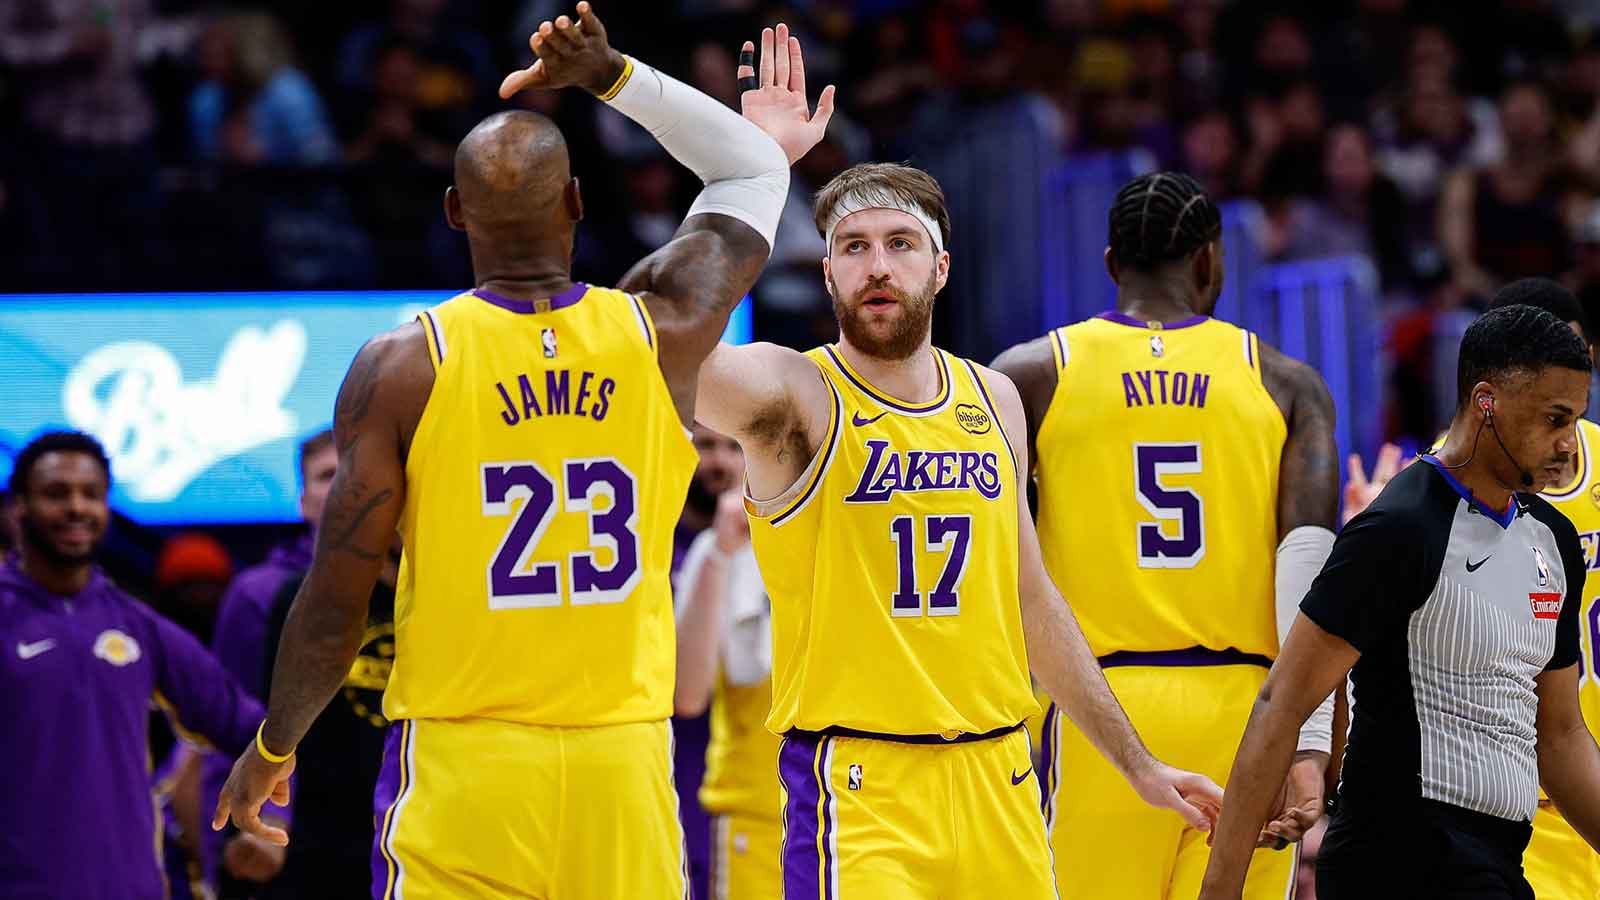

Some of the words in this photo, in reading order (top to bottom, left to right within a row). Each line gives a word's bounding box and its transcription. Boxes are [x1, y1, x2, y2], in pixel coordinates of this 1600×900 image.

[495, 369, 616, 427] JAMES
[957, 410, 988, 426] bibigo
[1121, 370, 1210, 409] AYTON
[844, 439, 1002, 504] LAKERS
[480, 456, 643, 611] 23
[1133, 442, 1206, 569] 5
[890, 514, 972, 617] 17
[1530, 598, 1561, 614] Emirates
